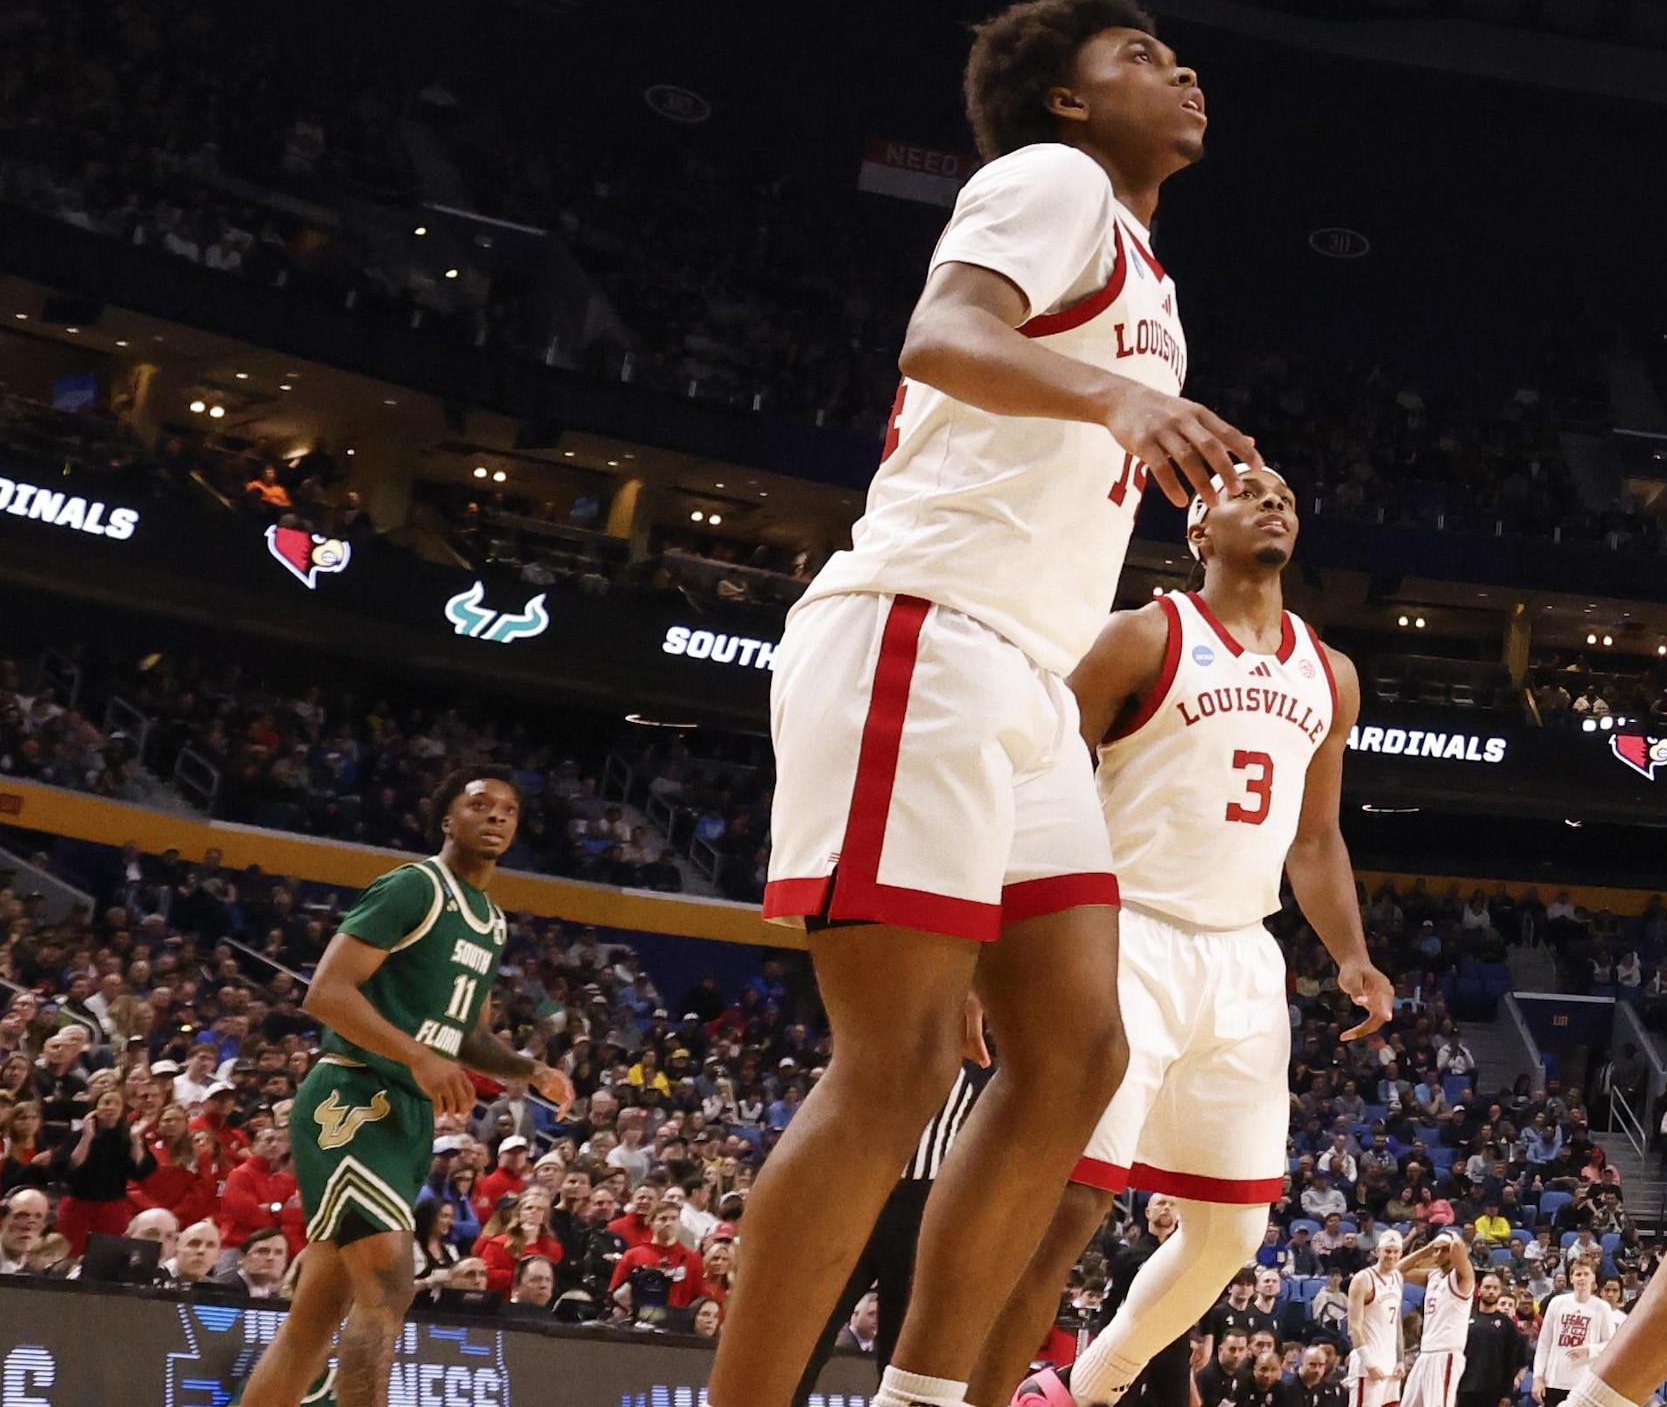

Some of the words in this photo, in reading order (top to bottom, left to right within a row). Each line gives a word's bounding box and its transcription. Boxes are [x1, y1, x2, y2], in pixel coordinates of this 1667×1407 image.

[0, 477, 140, 540] DINALS
[662, 626, 777, 671] SOUTH
[1177, 688, 1324, 744] LOUISVILLE
[1347, 725, 1507, 764] ARDINALS
[1225, 749, 1274, 826] 3
[450, 938, 493, 975] SOUTH
[444, 974, 477, 1024] 11
